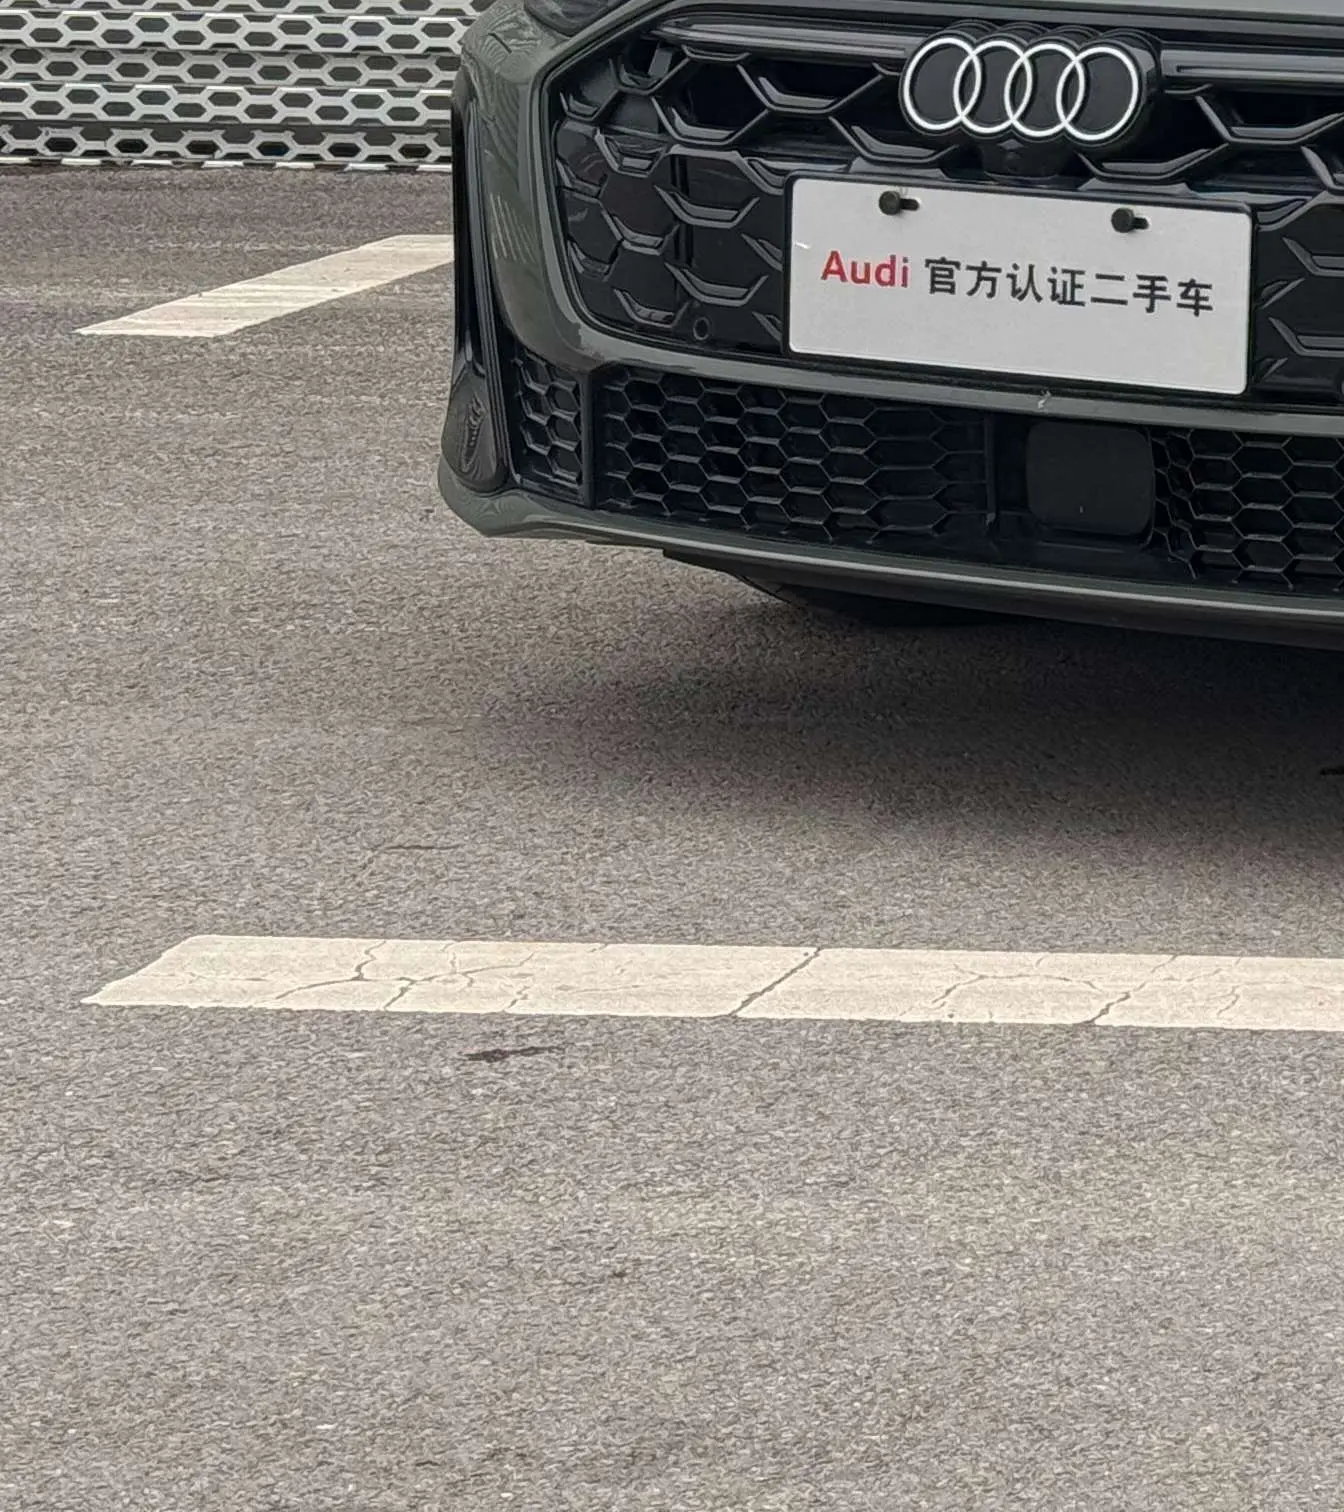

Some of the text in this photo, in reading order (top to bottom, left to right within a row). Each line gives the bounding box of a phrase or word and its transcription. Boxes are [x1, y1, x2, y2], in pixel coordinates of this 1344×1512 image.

[821, 251, 1214, 317] Audi 官方认证二手车
